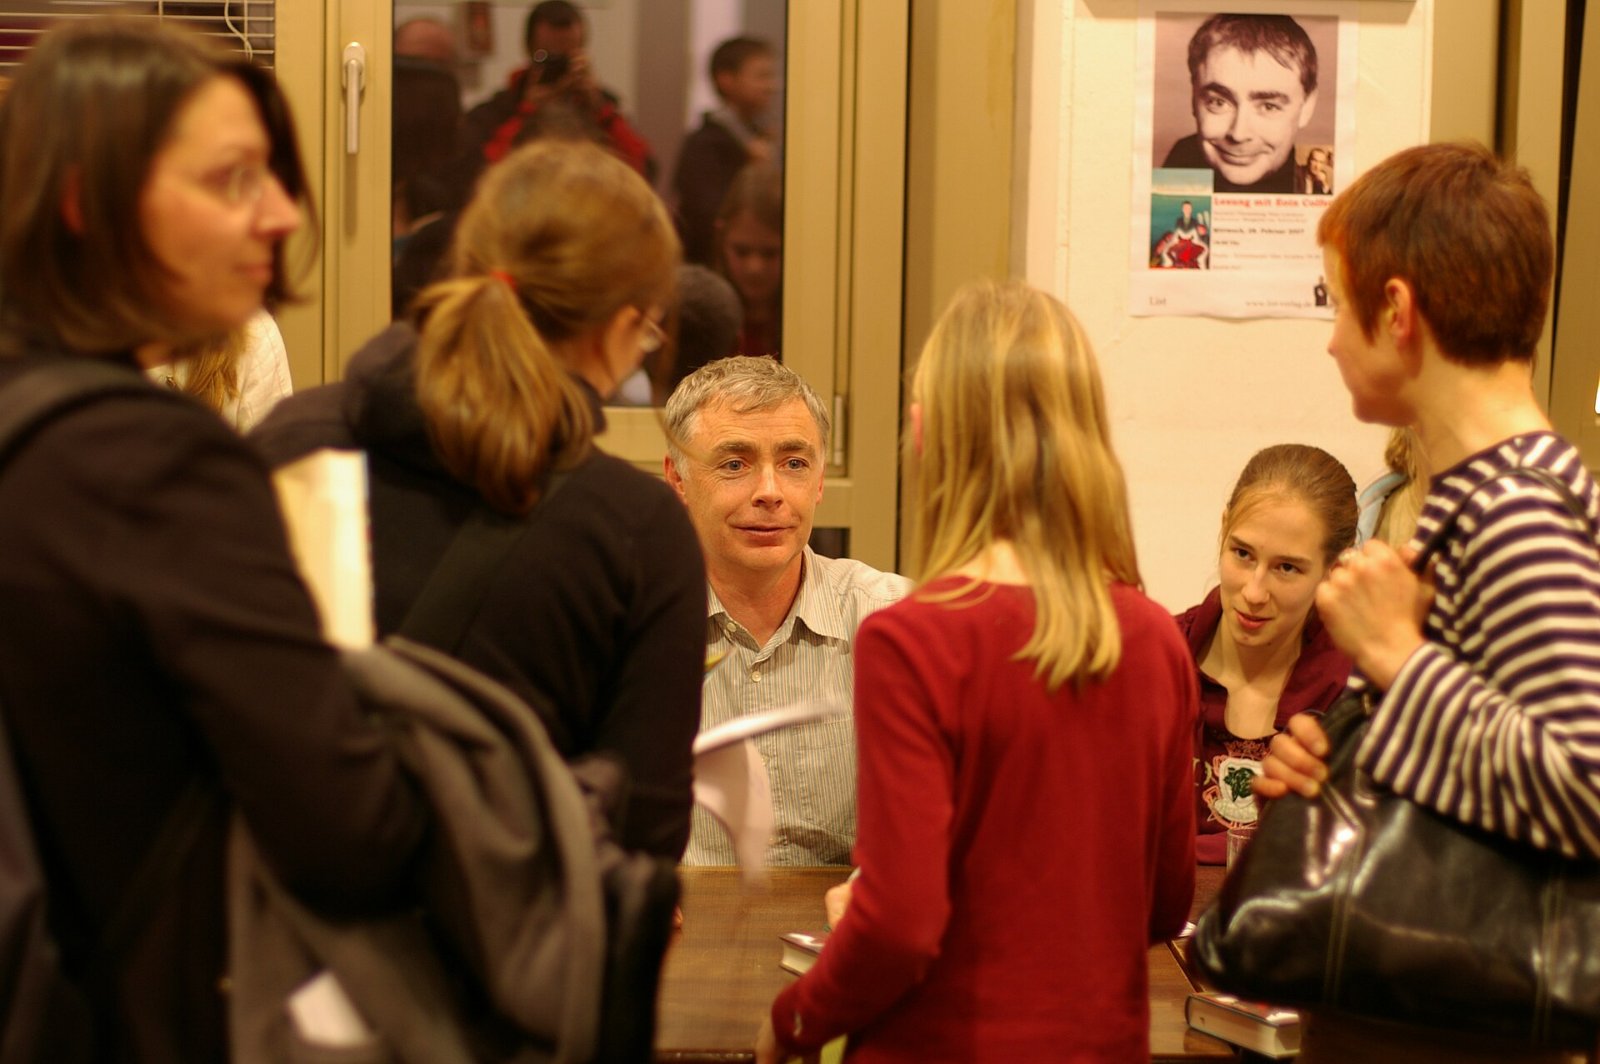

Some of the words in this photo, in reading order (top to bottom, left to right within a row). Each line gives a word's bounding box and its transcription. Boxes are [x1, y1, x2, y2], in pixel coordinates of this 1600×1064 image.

[1213, 197, 1251, 208] Lesung
[1254, 197, 1272, 207] mit
[1149, 296, 1168, 306] List
